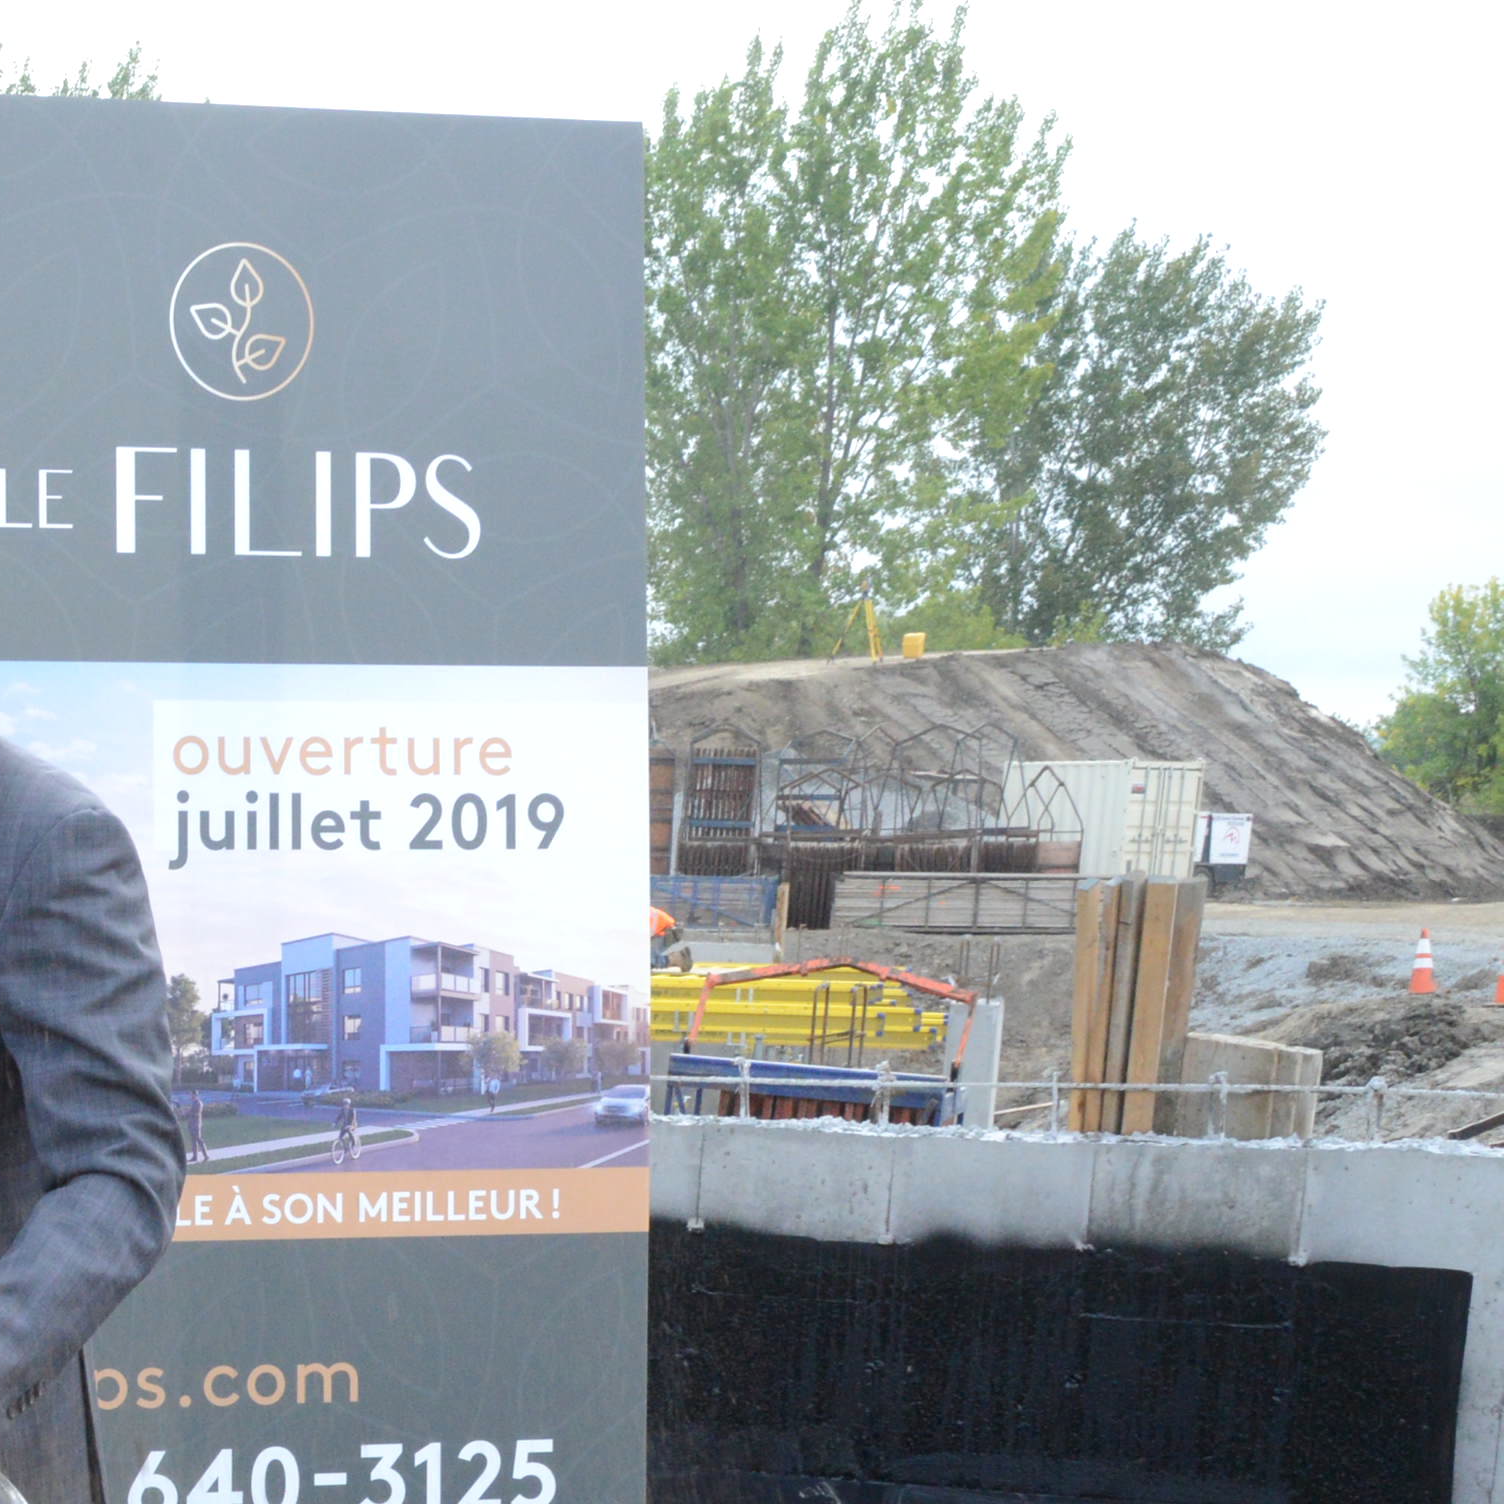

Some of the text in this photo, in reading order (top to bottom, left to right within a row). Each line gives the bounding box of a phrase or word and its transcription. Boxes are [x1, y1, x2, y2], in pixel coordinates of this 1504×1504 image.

[115, 446, 482, 560] FILIPS
[172, 726, 513, 776] ouverture
[168, 791, 565, 870] juillet 2019
[175, 1194, 214, 1227] LE
[224, 1185, 252, 1226] À
[261, 1191, 344, 1226] SON
[94, 1361, 359, 1411] ps.com
